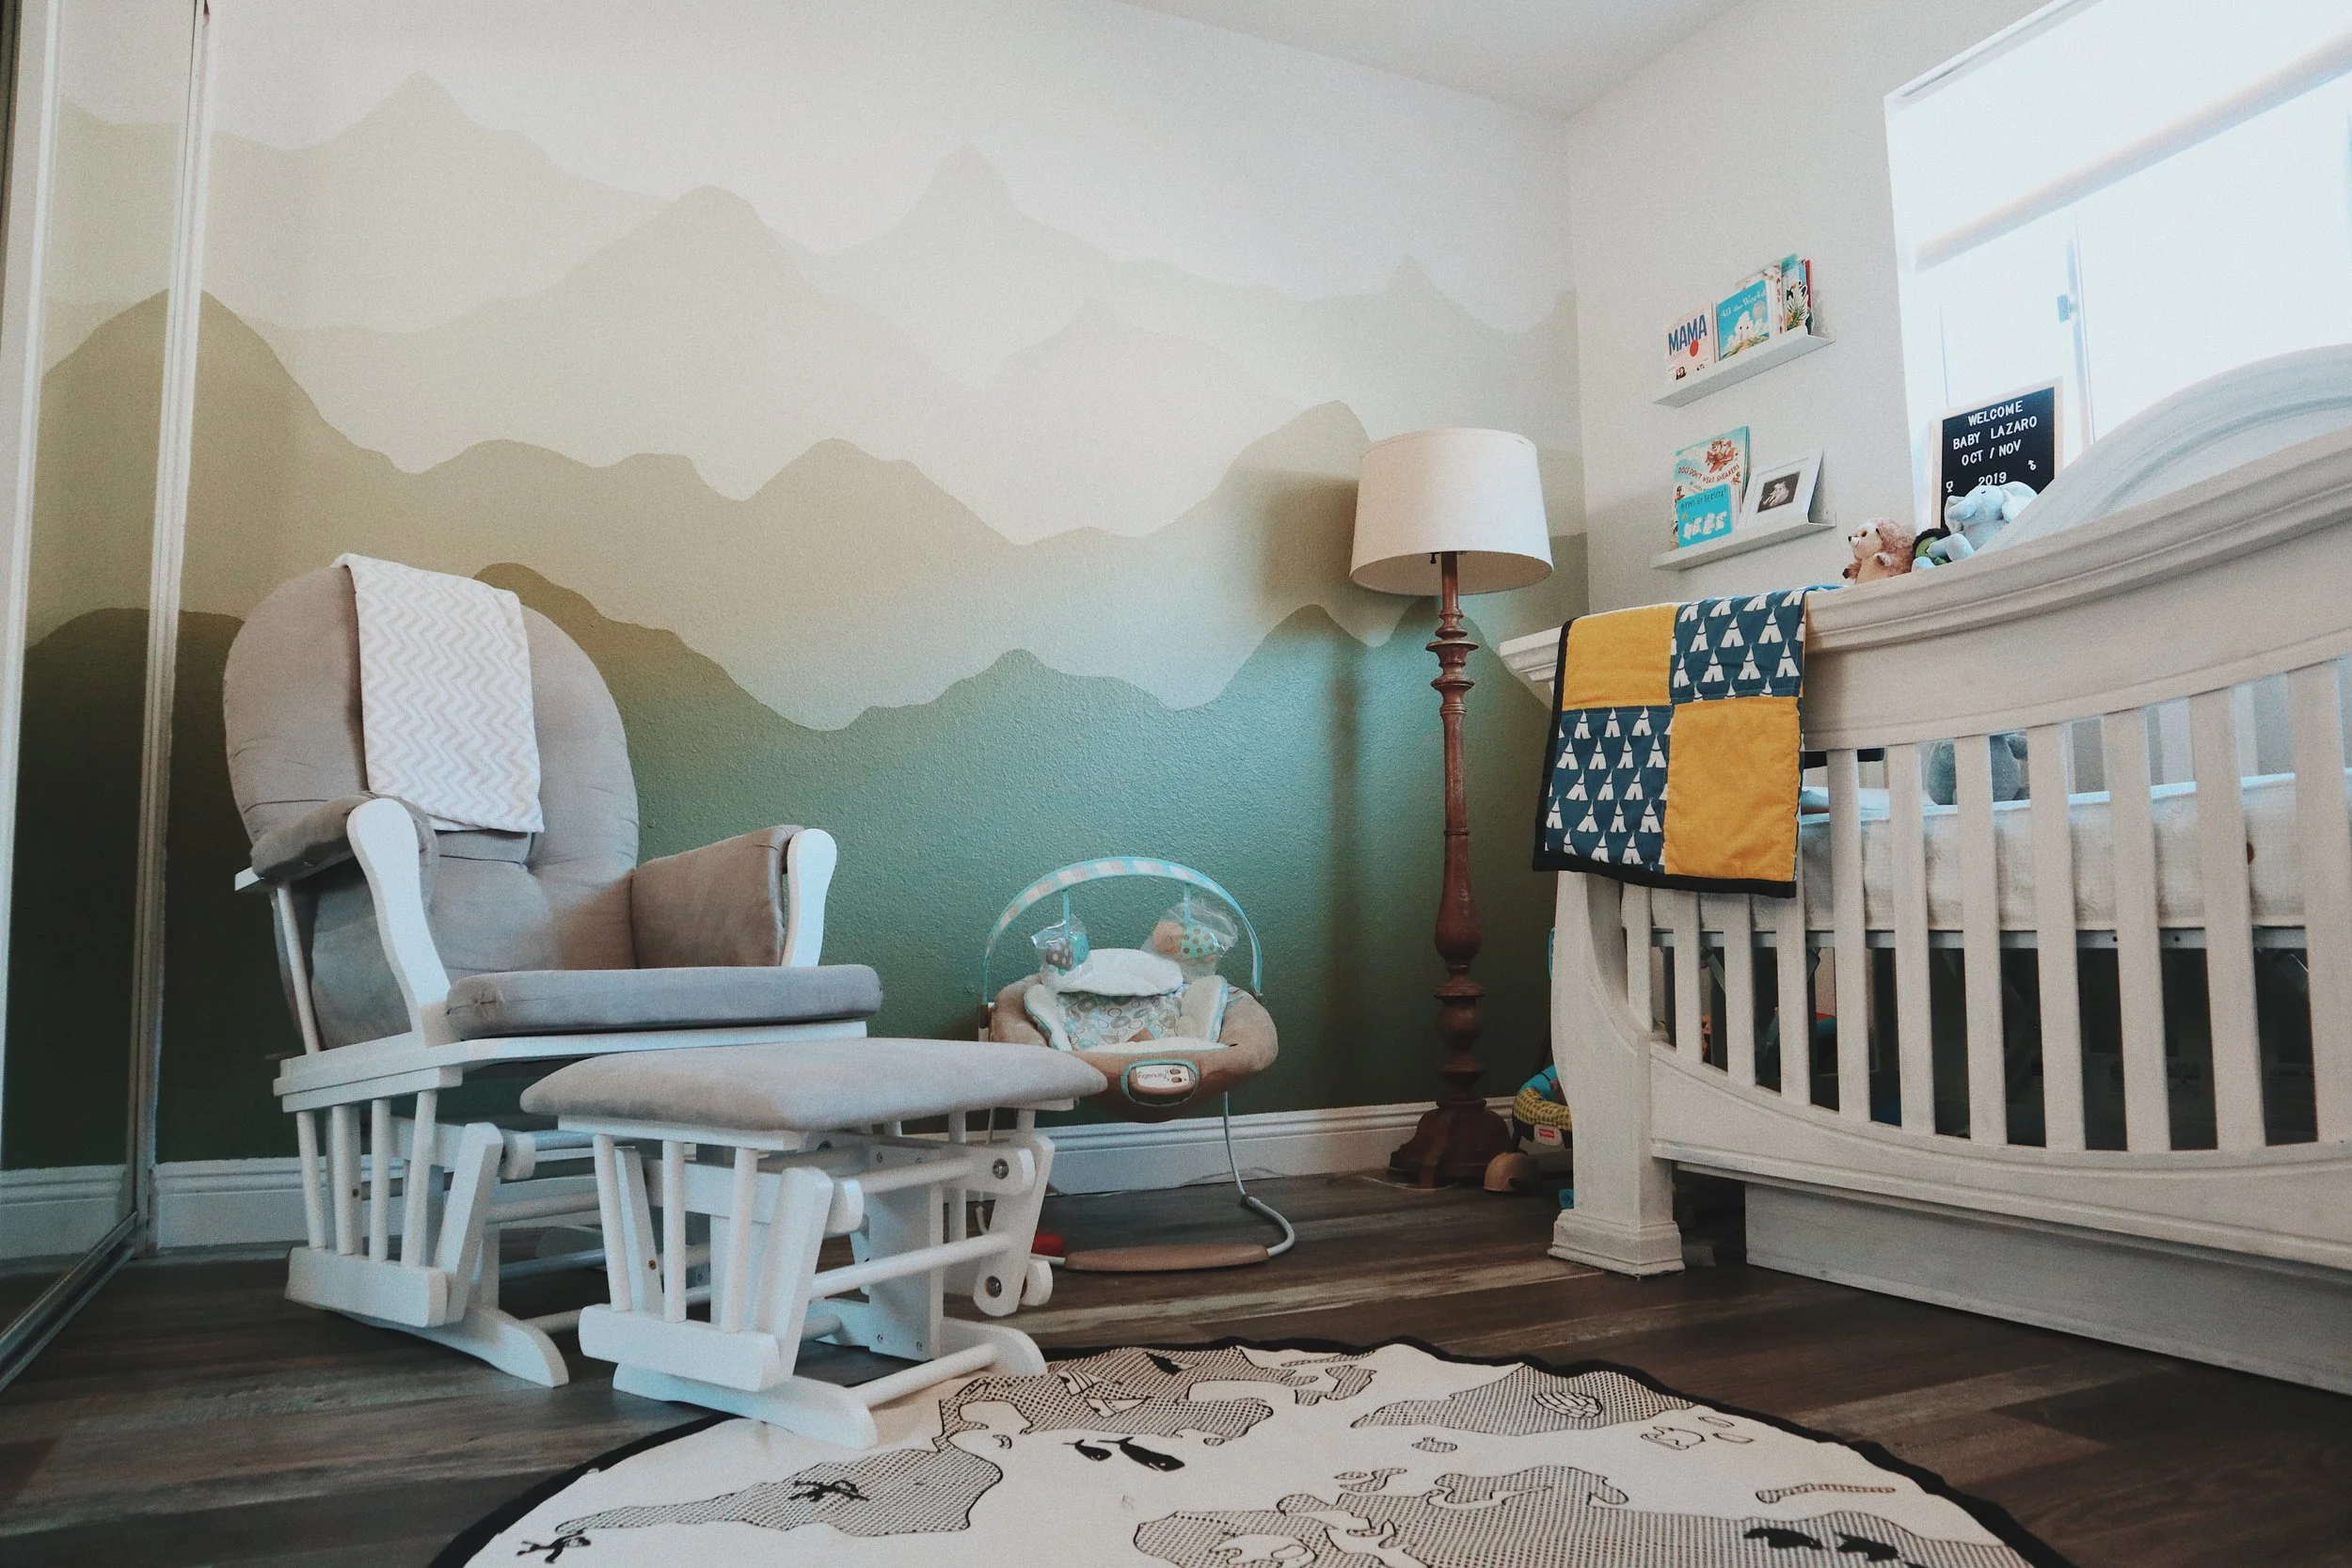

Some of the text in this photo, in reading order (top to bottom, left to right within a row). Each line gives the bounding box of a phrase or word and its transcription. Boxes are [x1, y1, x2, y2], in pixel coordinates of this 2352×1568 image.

[1721, 307, 1731, 317] All
[1742, 289, 1766, 306] World
[1668, 314, 1707, 356] MAMA
[1968, 400, 2024, 426] WELCOME
[1952, 416, 2037, 450] BABY LAZARO
[1962, 450, 1983, 466] OCT
[1998, 439, 2022, 457] NOV
[1678, 466, 1690, 474] DOGS
[1717, 463, 1740, 483] SNEAKERS
[1979, 471, 2007, 486] 2019
